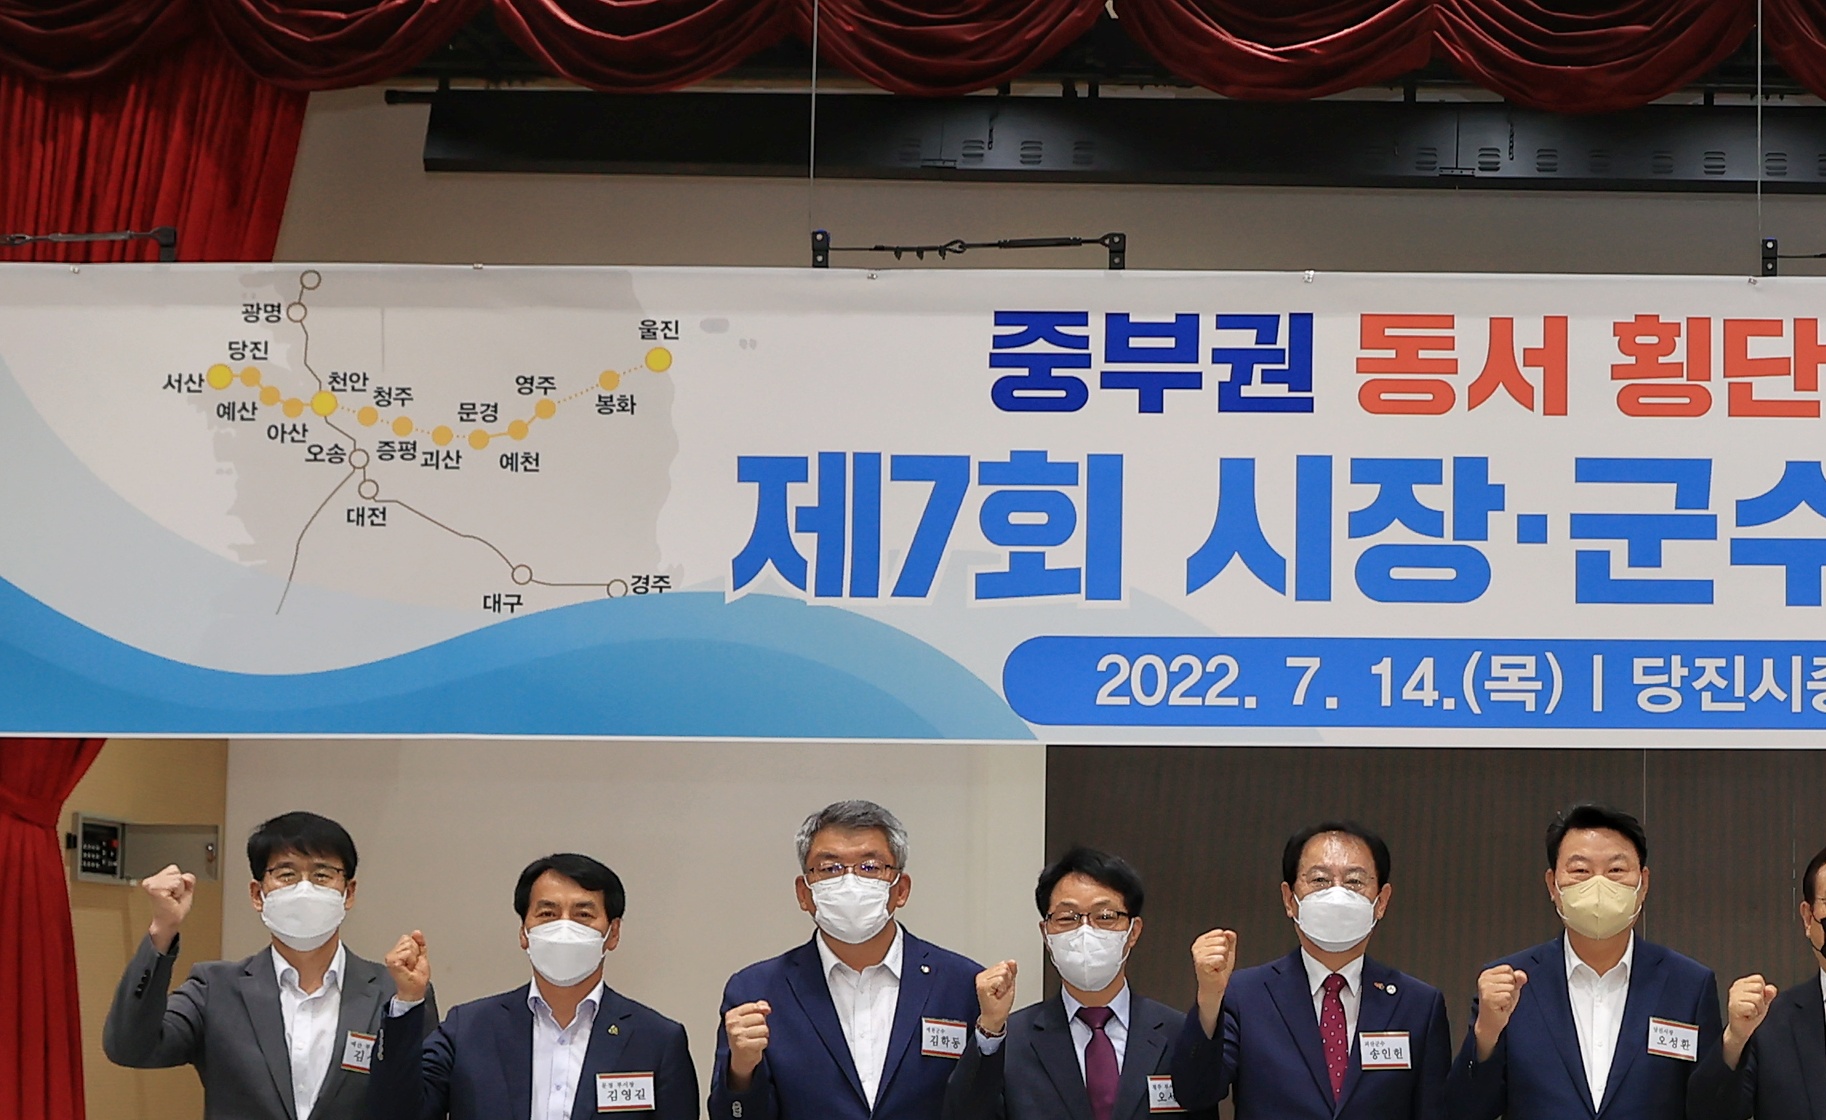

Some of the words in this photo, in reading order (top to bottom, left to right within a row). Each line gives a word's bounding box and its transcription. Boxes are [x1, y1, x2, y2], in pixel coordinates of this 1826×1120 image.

[244, 304, 282, 324] 광명
[641, 321, 679, 341] 울진
[230, 342, 268, 361] 당진
[991, 313, 1314, 414] 중부권
[1358, 315, 1568, 416] 동서
[165, 375, 204, 393] 서산
[330, 373, 369, 392] 천안
[517, 377, 557, 396] 영주
[375, 388, 414, 408] 청주
[597, 396, 637, 415] 봉화
[218, 403, 258, 422] 예산
[459, 404, 498, 423] 문경
[269, 425, 309, 444] 아산
[305, 444, 346, 464] 오송
[378, 442, 417, 462] 증평
[422, 451, 462, 470] 괴산
[501, 453, 540, 473] 예천
[348, 508, 387, 527] 대전
[734, 452, 1124, 601] 제7회
[633, 576, 672, 595] 경주
[485, 595, 523, 614] 대구
[1097, 656, 1257, 709] 2022.
[1288, 659, 1338, 709] 7.
[1373, 653, 1563, 714] 14.(목)
[929, 1034, 961, 1050] 김학동
[1657, 1035, 1691, 1051] 오성환
[1369, 1047, 1404, 1060] 송인헌
